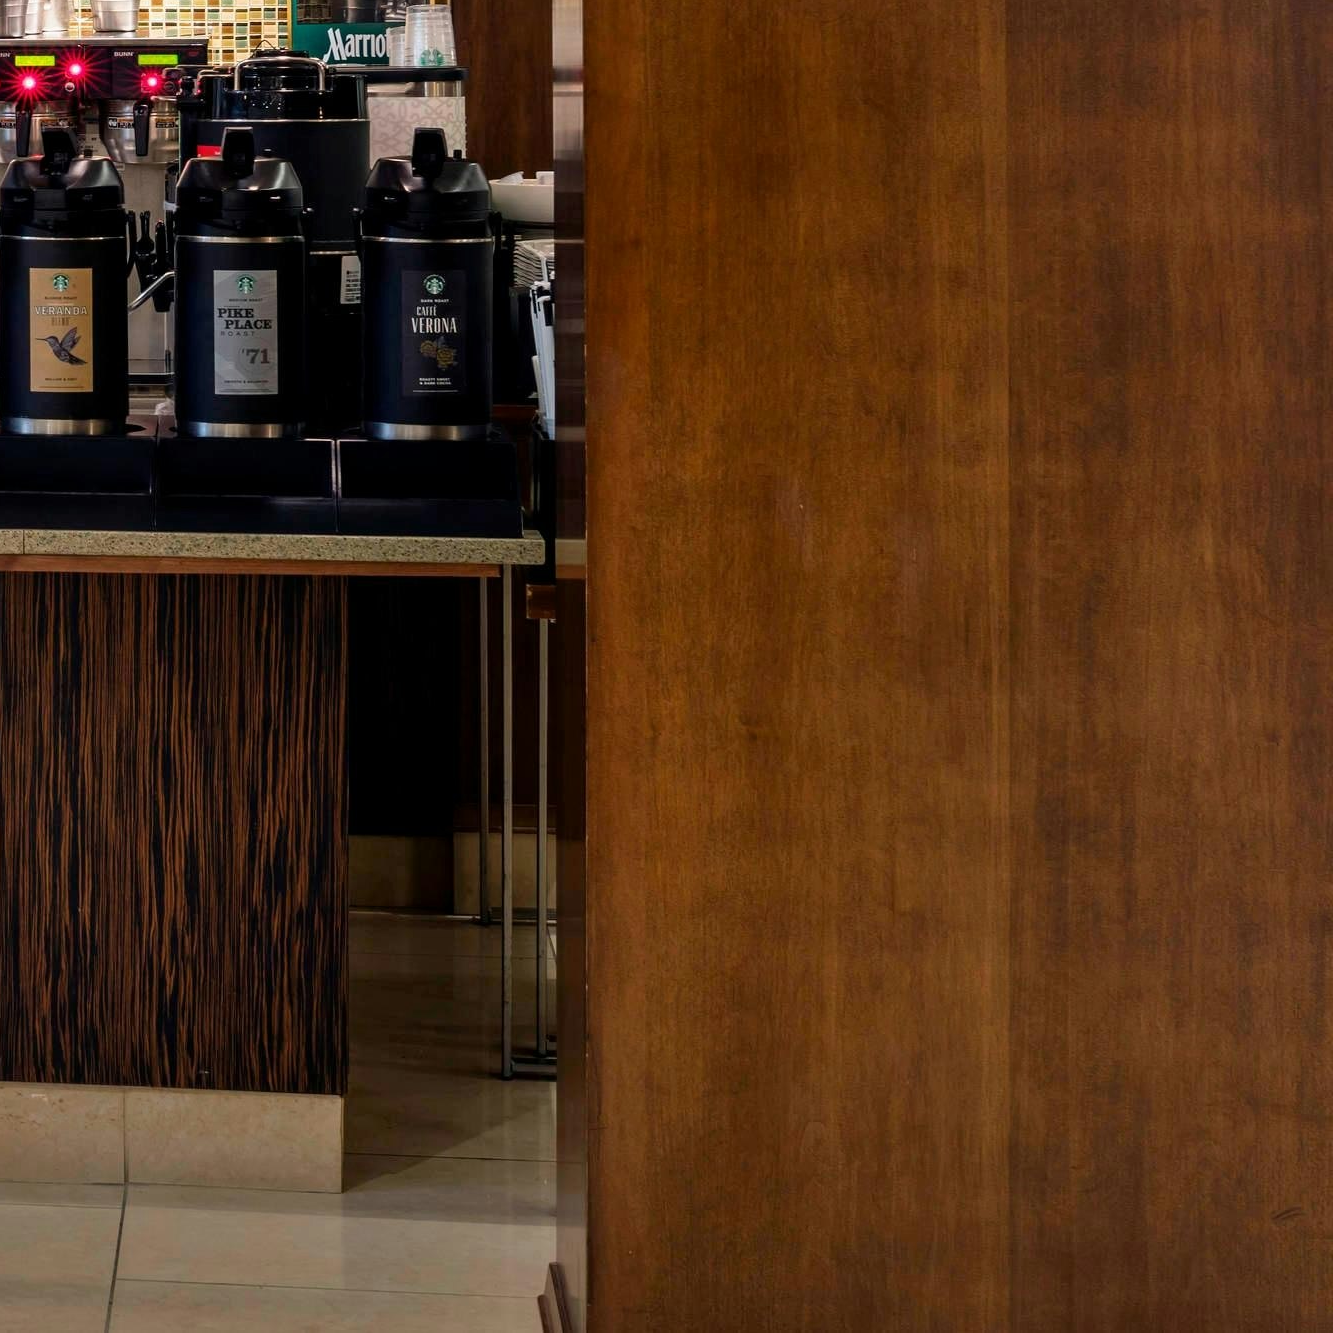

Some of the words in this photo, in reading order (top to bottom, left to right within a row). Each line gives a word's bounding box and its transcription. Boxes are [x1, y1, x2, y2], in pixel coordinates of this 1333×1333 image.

[323, 27, 390, 62] Marriot
[34, 305, 88, 316] VERANDA
[217, 308, 254, 318] PIKE
[225, 319, 272, 330] PLACE
[411, 317, 457, 333] VERONA
